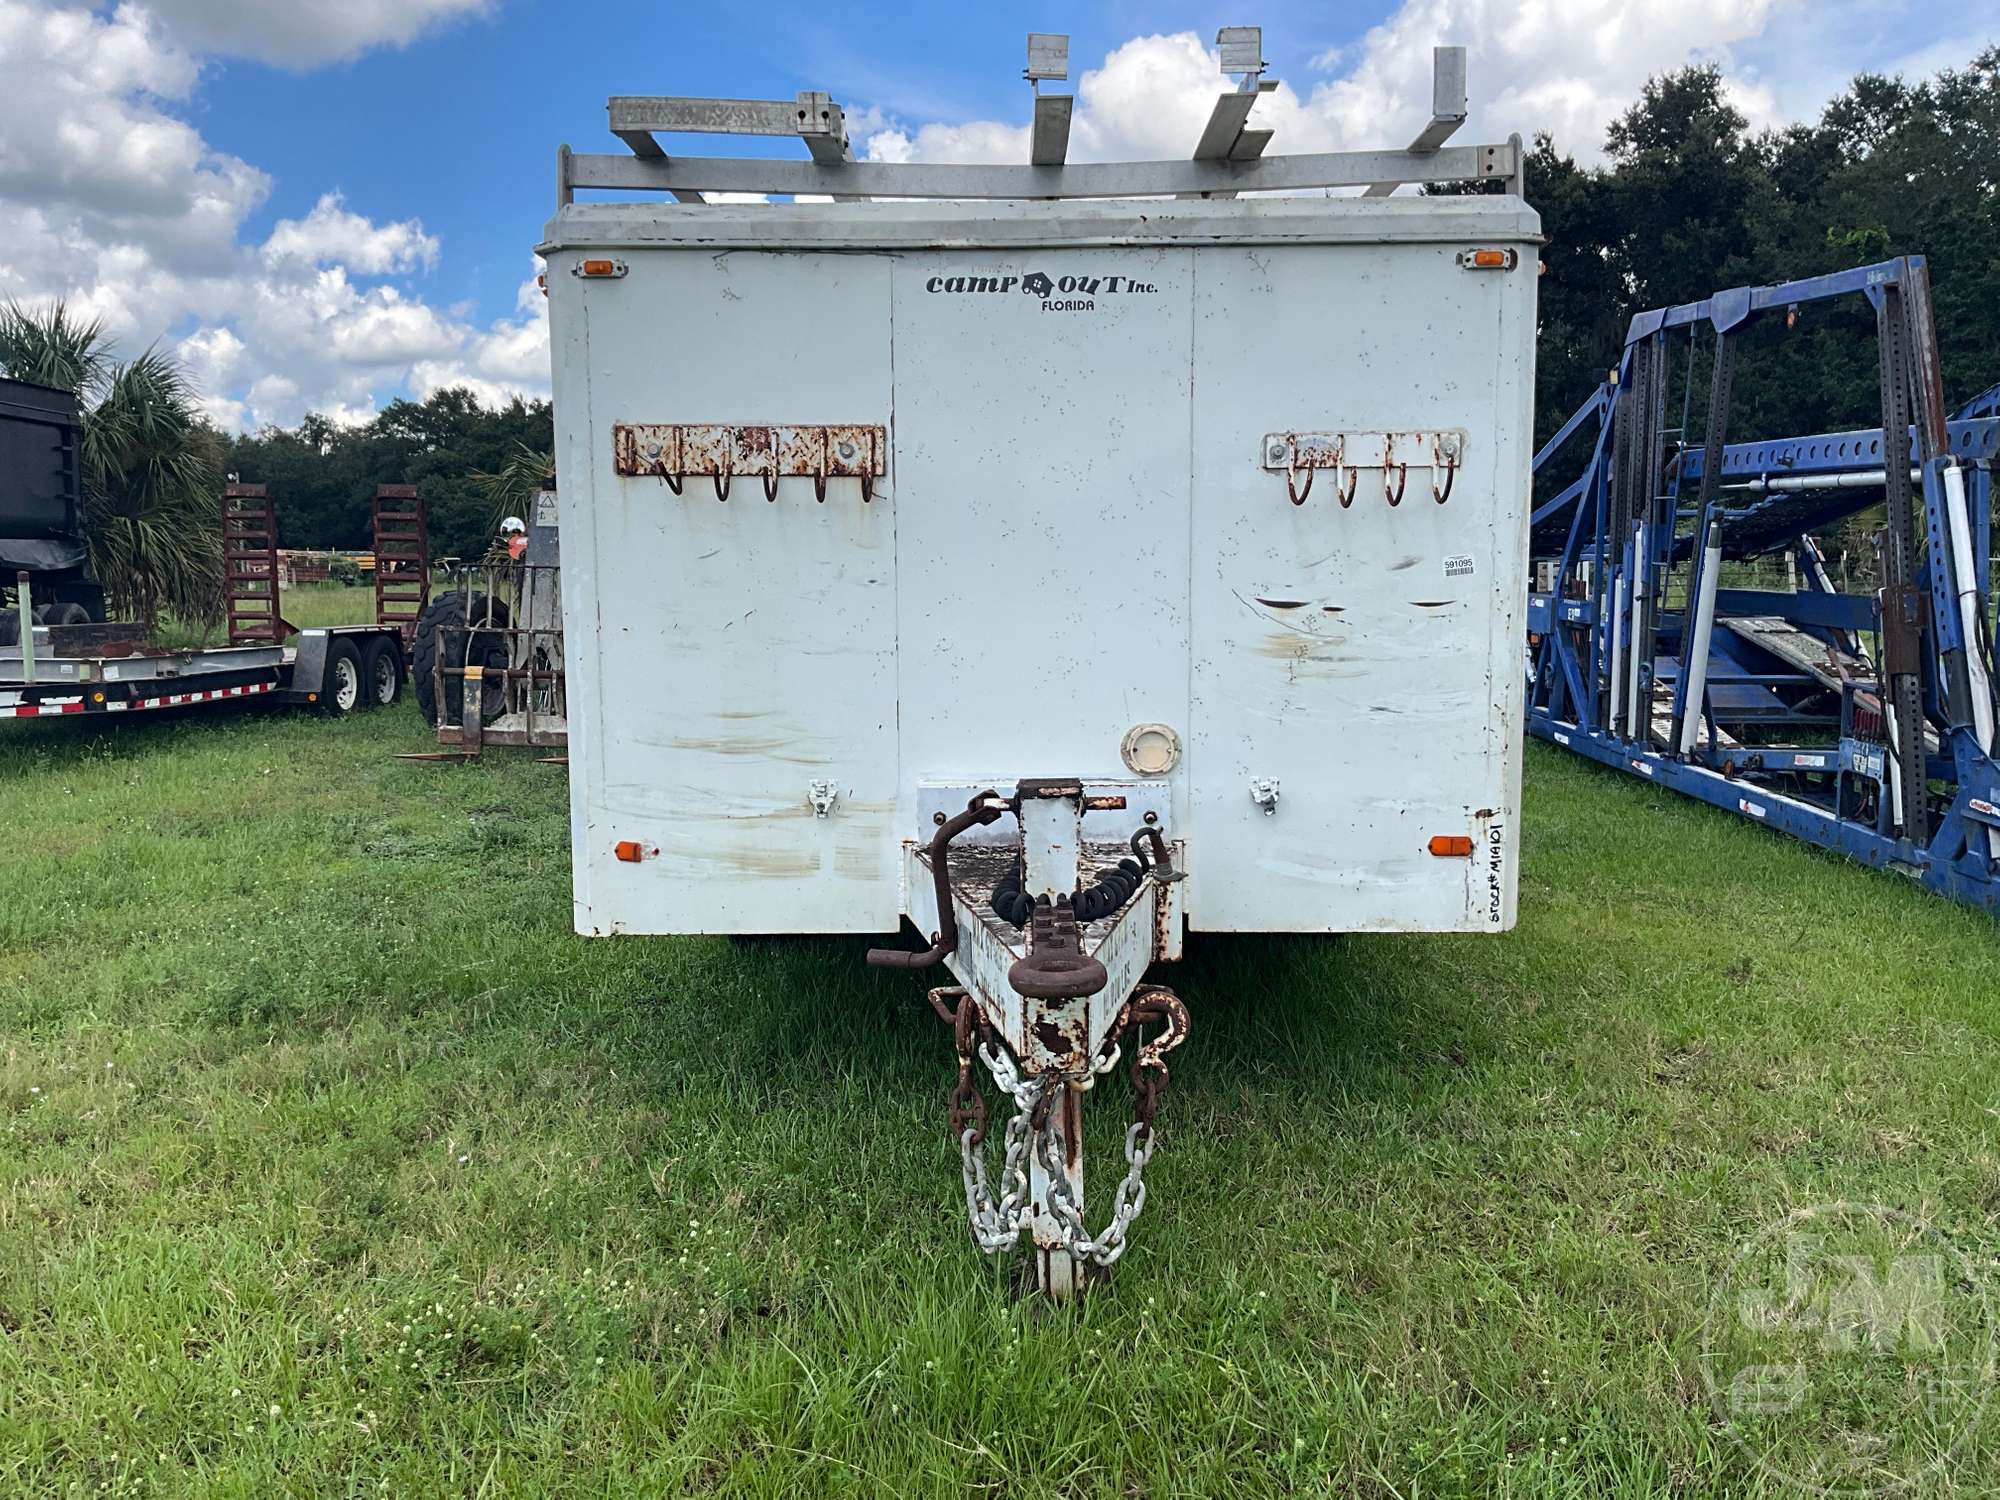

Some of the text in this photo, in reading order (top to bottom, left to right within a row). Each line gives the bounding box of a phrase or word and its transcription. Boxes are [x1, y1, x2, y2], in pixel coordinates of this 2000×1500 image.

[1127, 280, 1159, 293] Inc.
[1042, 300, 1095, 311] FLORIDA
[1444, 558, 1473, 569] 591095
